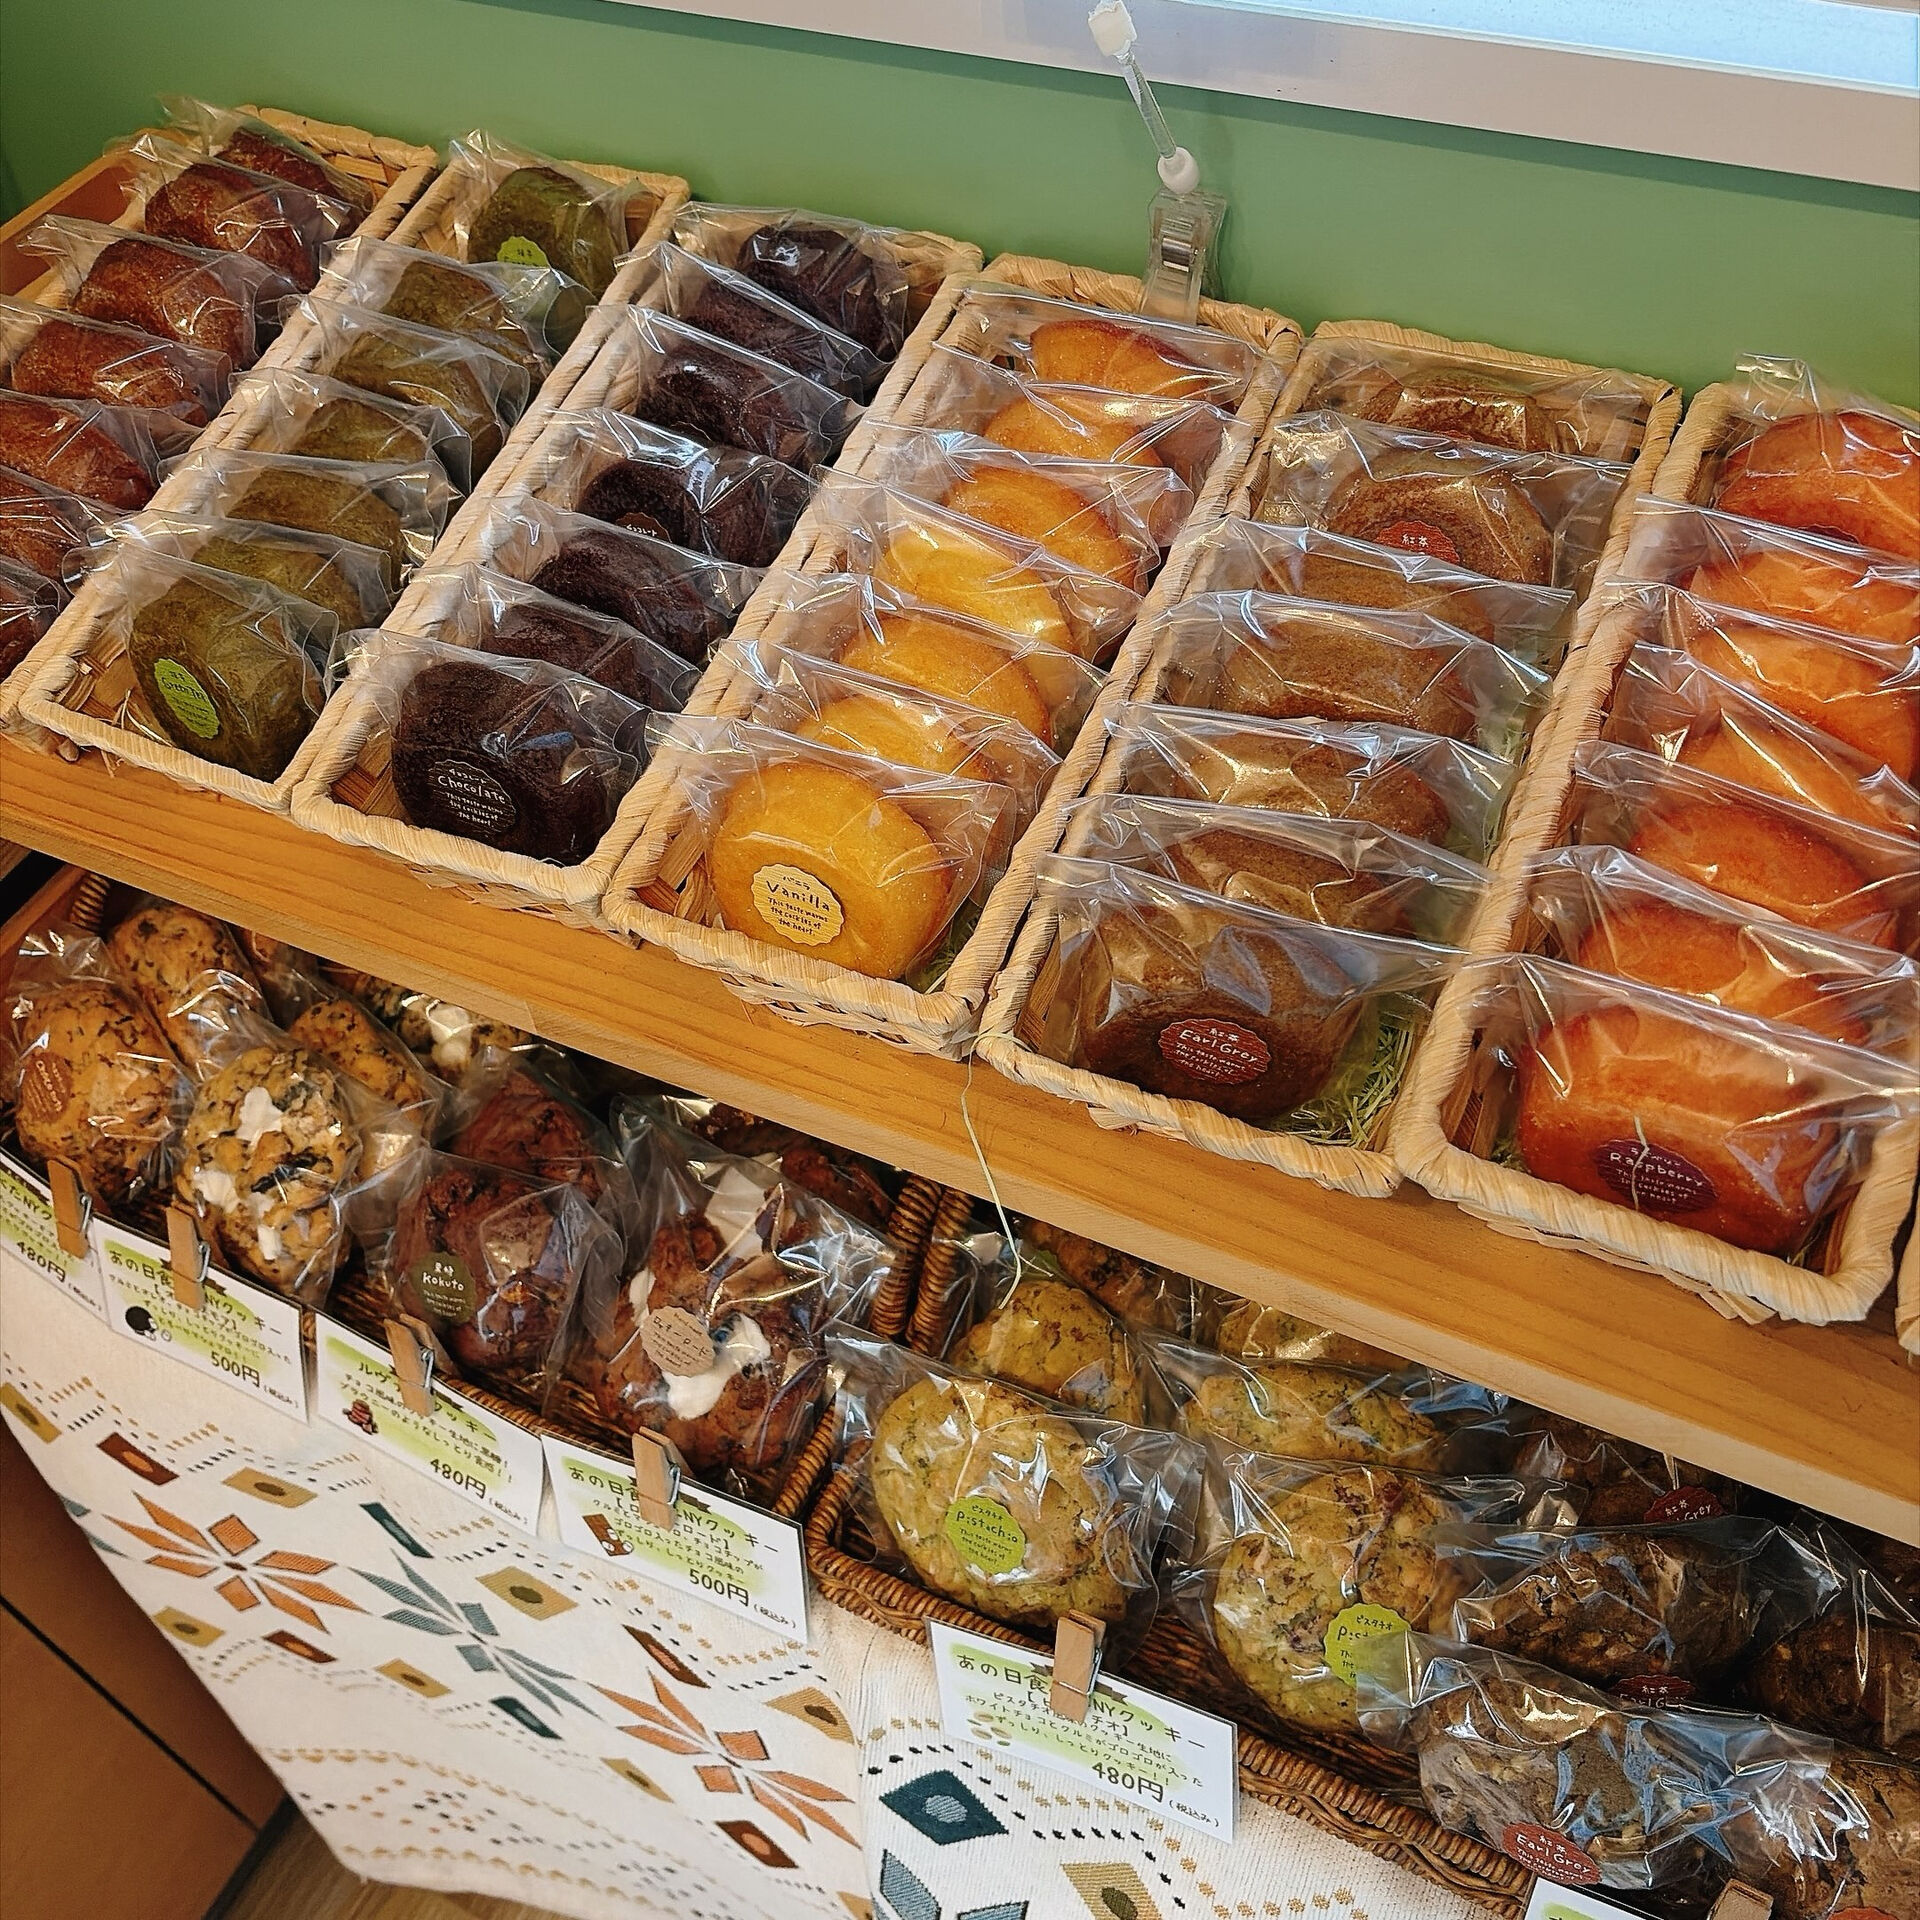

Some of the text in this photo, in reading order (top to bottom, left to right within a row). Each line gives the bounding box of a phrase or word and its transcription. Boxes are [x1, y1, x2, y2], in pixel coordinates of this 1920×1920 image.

[437, 775, 506, 804] Chocolate
[766, 880, 830, 912] Vanilla
[782, 876, 811, 890] バニラ
[767, 896, 829, 922] This taste warms
[770, 906, 822, 930] the cockles of
[778, 917, 791, 927] the
[1179, 1029, 1259, 1063] Earl Grey
[1208, 1028, 1240, 1043] 紅茶
[17, 1241, 66, 1283] 480円
[422, 1271, 465, 1291] Kokuto
[210, 1351, 260, 1388] 500円
[430, 1458, 486, 1500] 480円
[956, 1510, 1018, 1543] Pistachio
[689, 1568, 749, 1608] 500円
[1356, 1614, 1393, 1631] ピスタチオ
[1091, 1762, 1164, 1803] 480円
[1516, 1832, 1549, 1857] Earl
